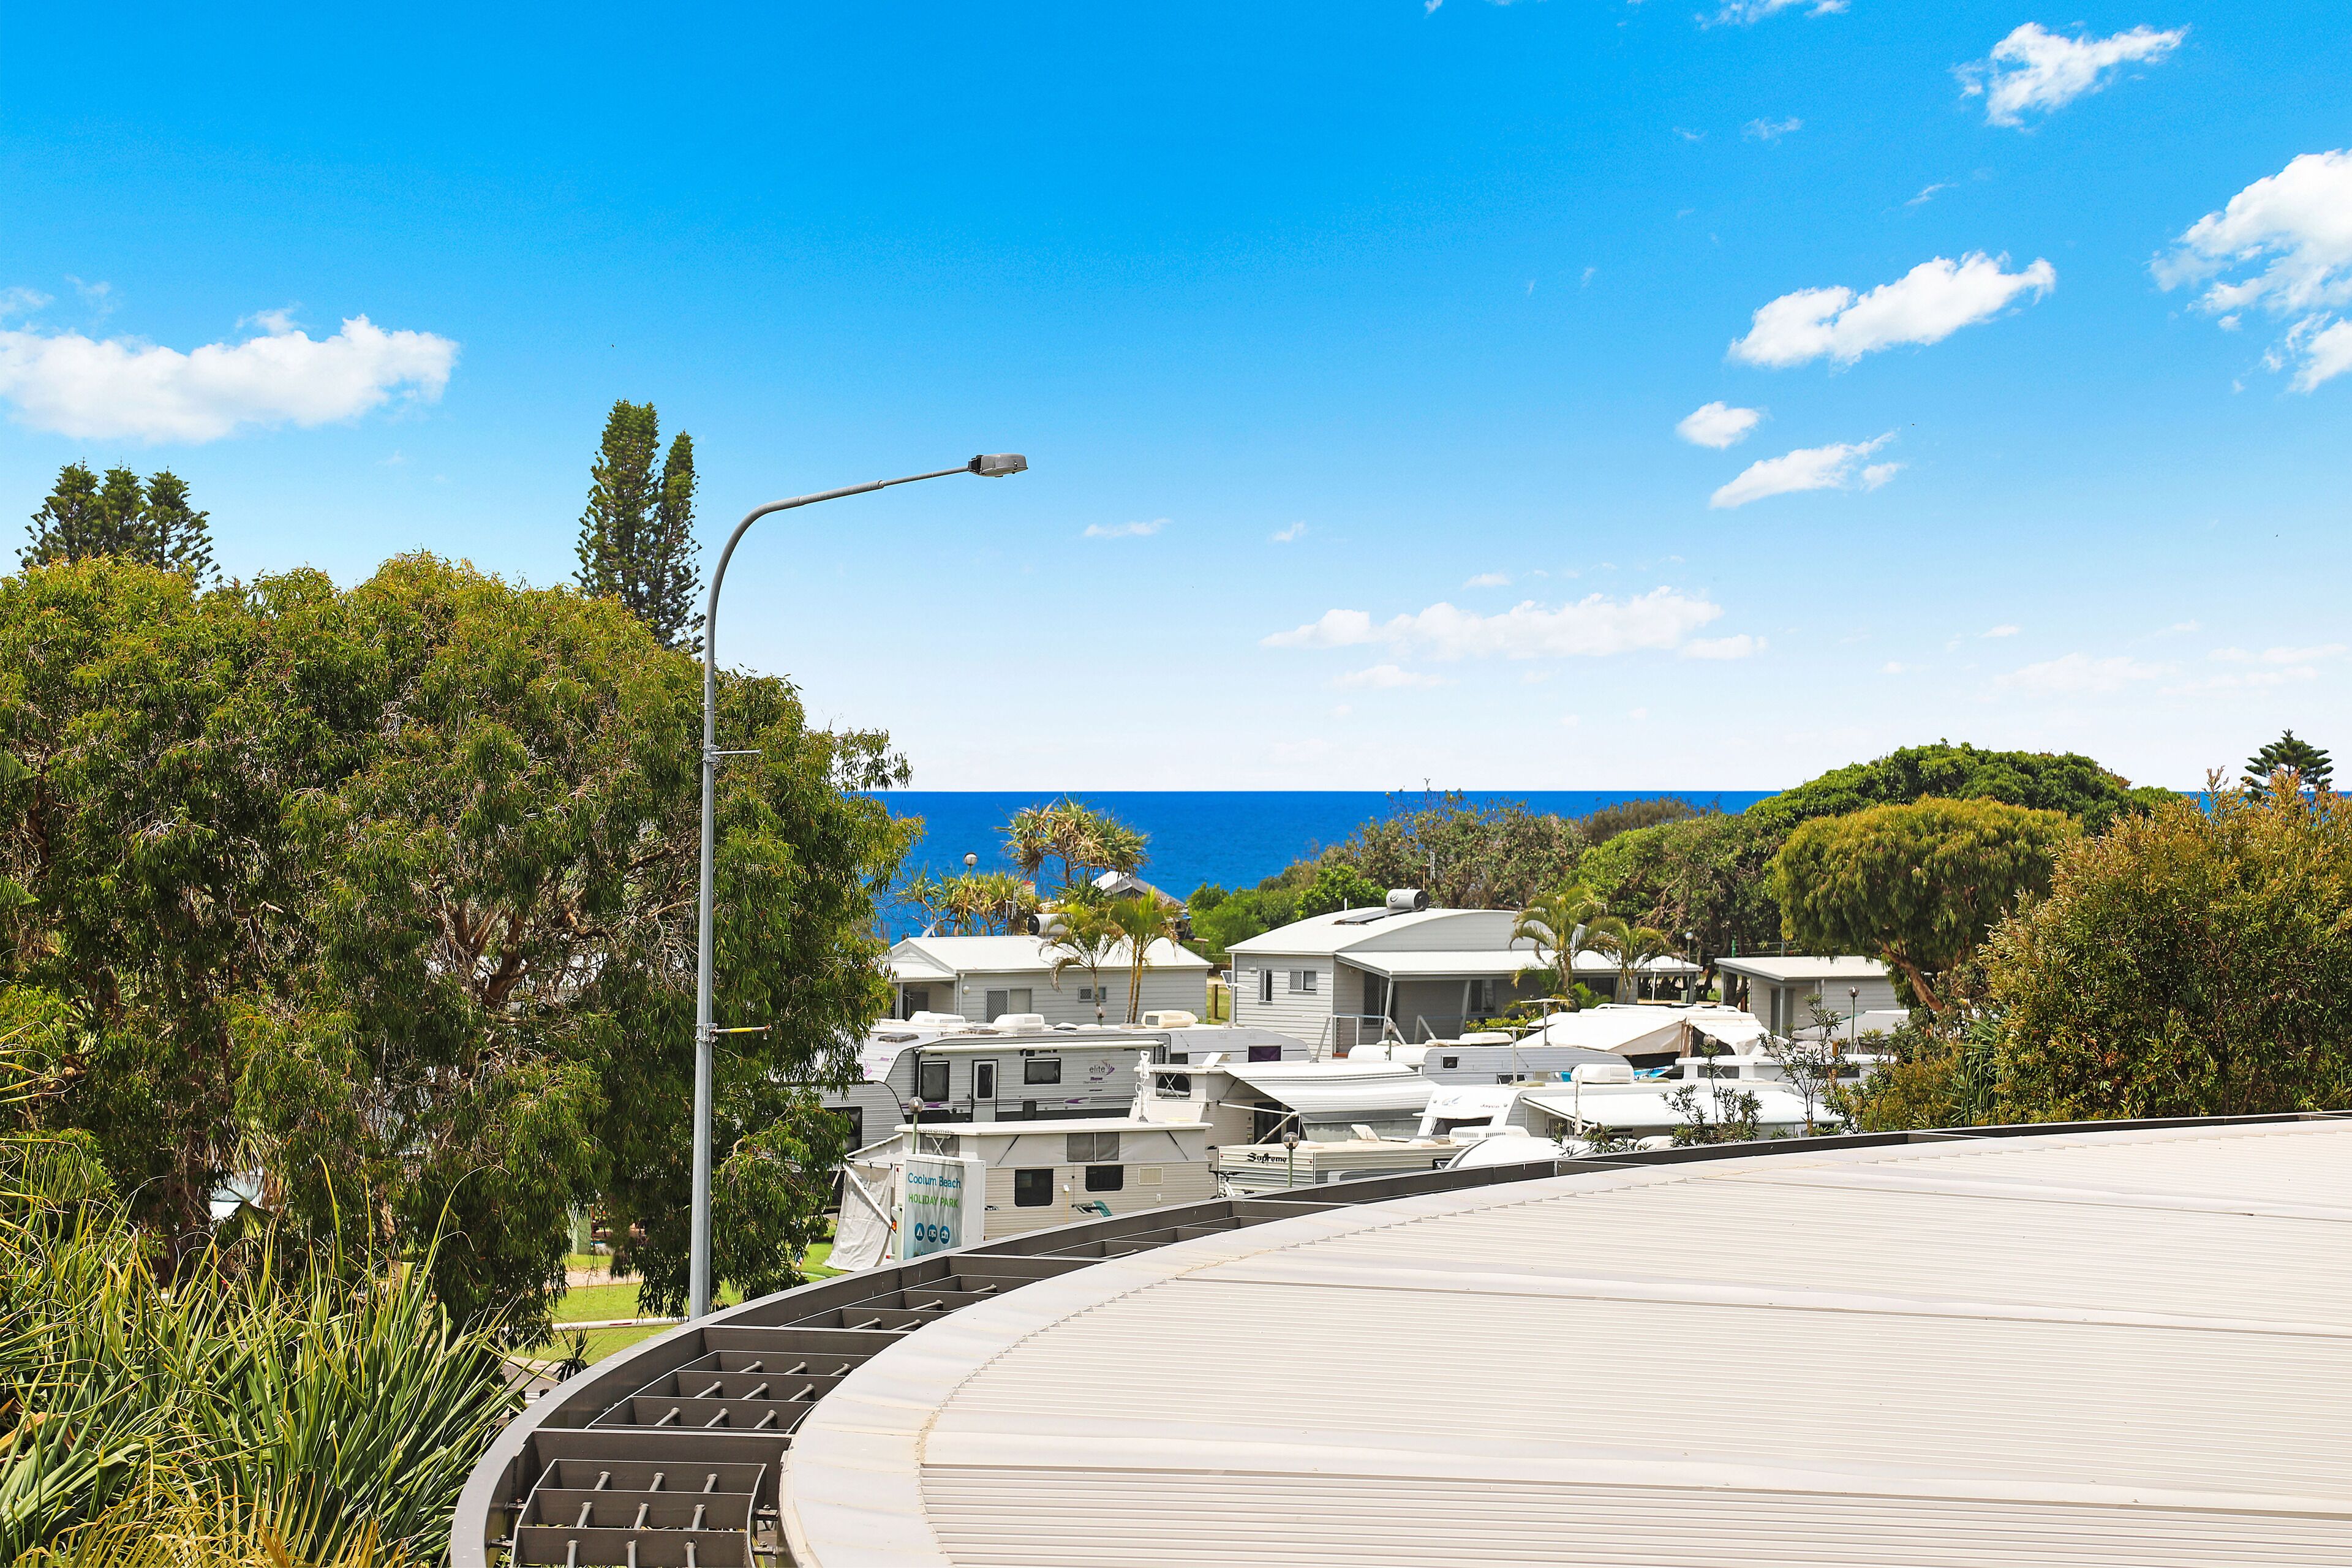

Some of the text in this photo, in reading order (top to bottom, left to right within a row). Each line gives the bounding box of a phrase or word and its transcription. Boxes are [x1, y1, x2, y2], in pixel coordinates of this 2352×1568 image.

[1089, 1065, 1106, 1073] elite
[1247, 1152, 1287, 1164] Supreme
[908, 1172, 961, 1189] Coolum Beach
[908, 1193, 959, 1208] HOLIDAY PARK
